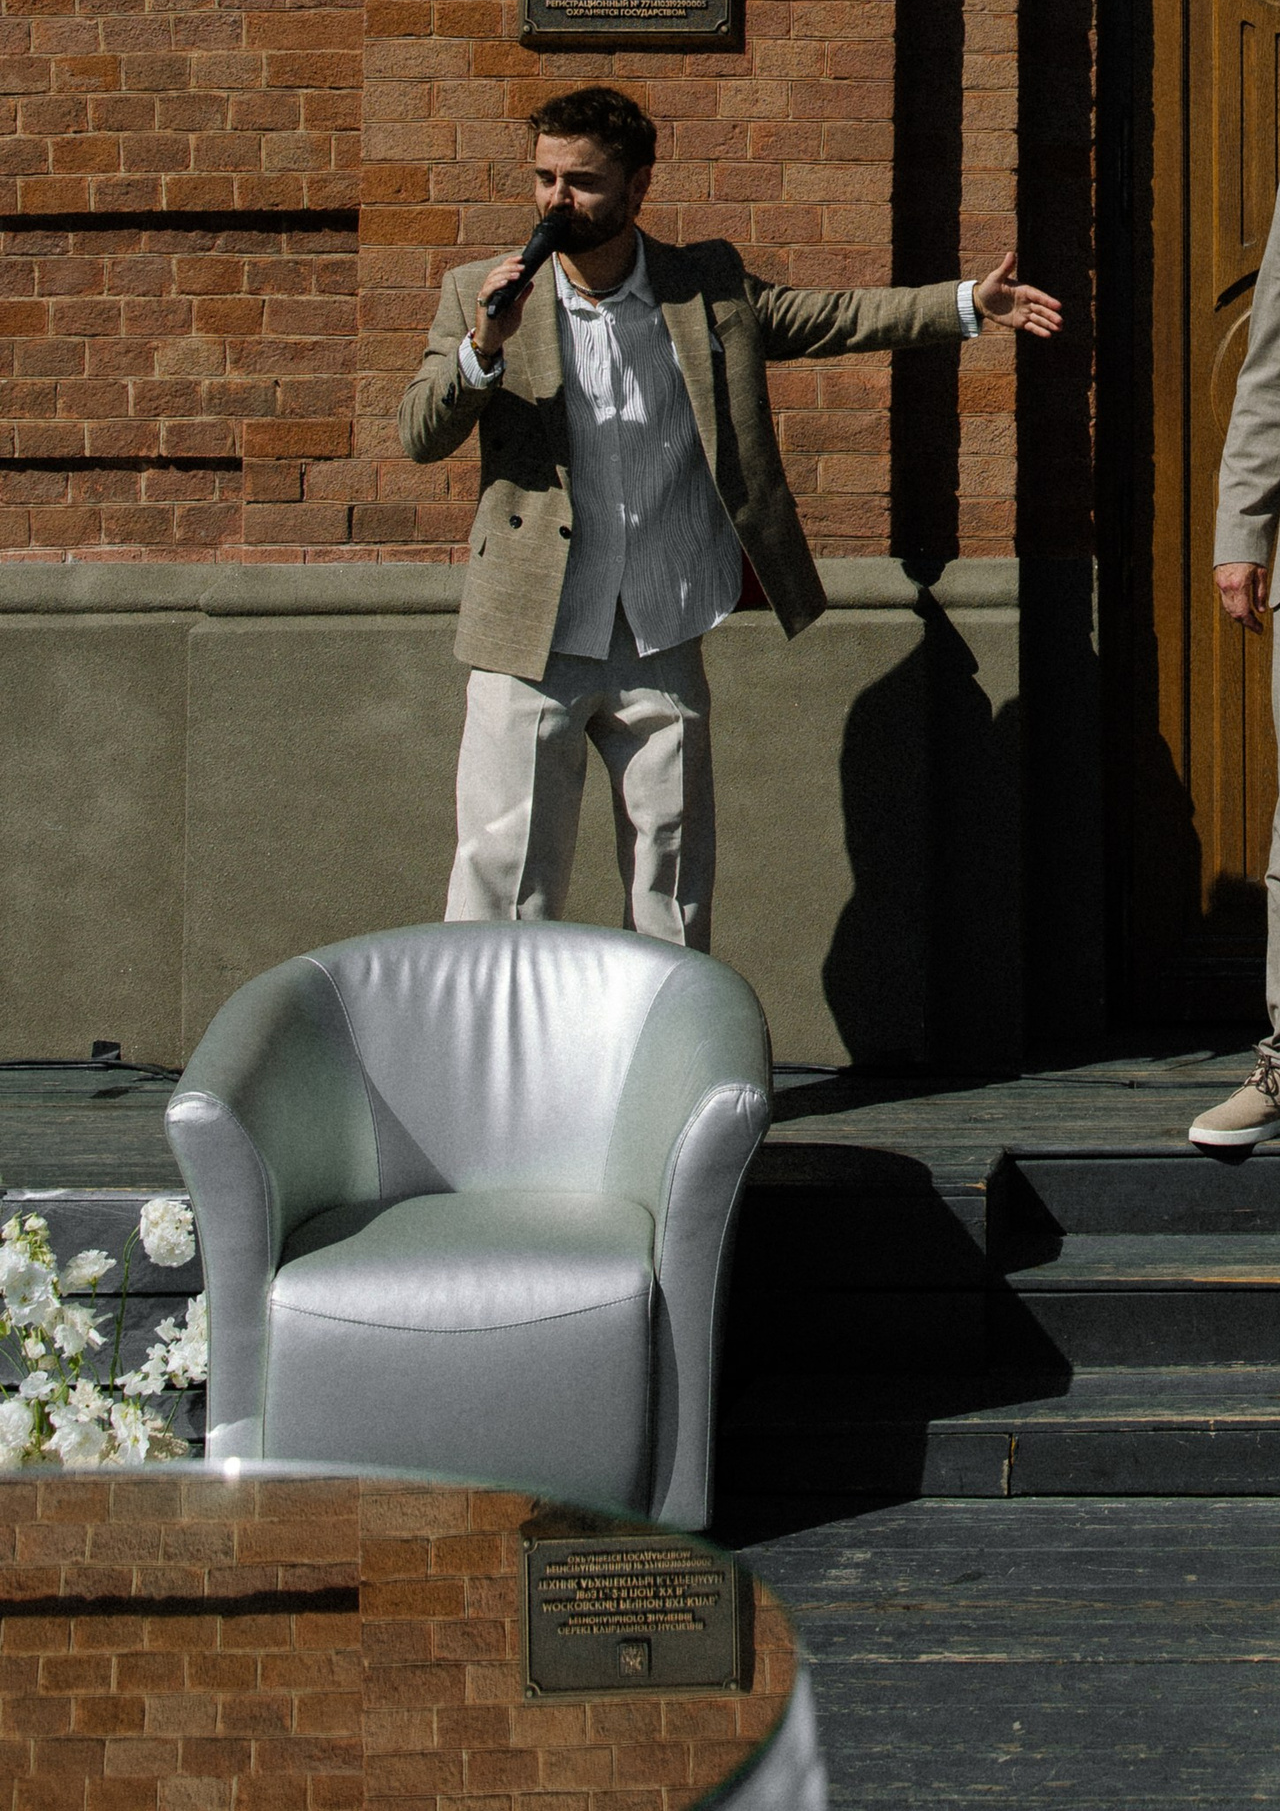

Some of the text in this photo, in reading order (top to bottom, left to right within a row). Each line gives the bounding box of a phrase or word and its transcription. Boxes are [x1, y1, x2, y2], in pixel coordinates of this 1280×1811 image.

[545, 0, 628, 8] РЕГИСТРАЦИОННЫЙ
[566, 8, 687, 17] ОХРАНЯЕТСЯ ГОСУДАРСТВОМ
